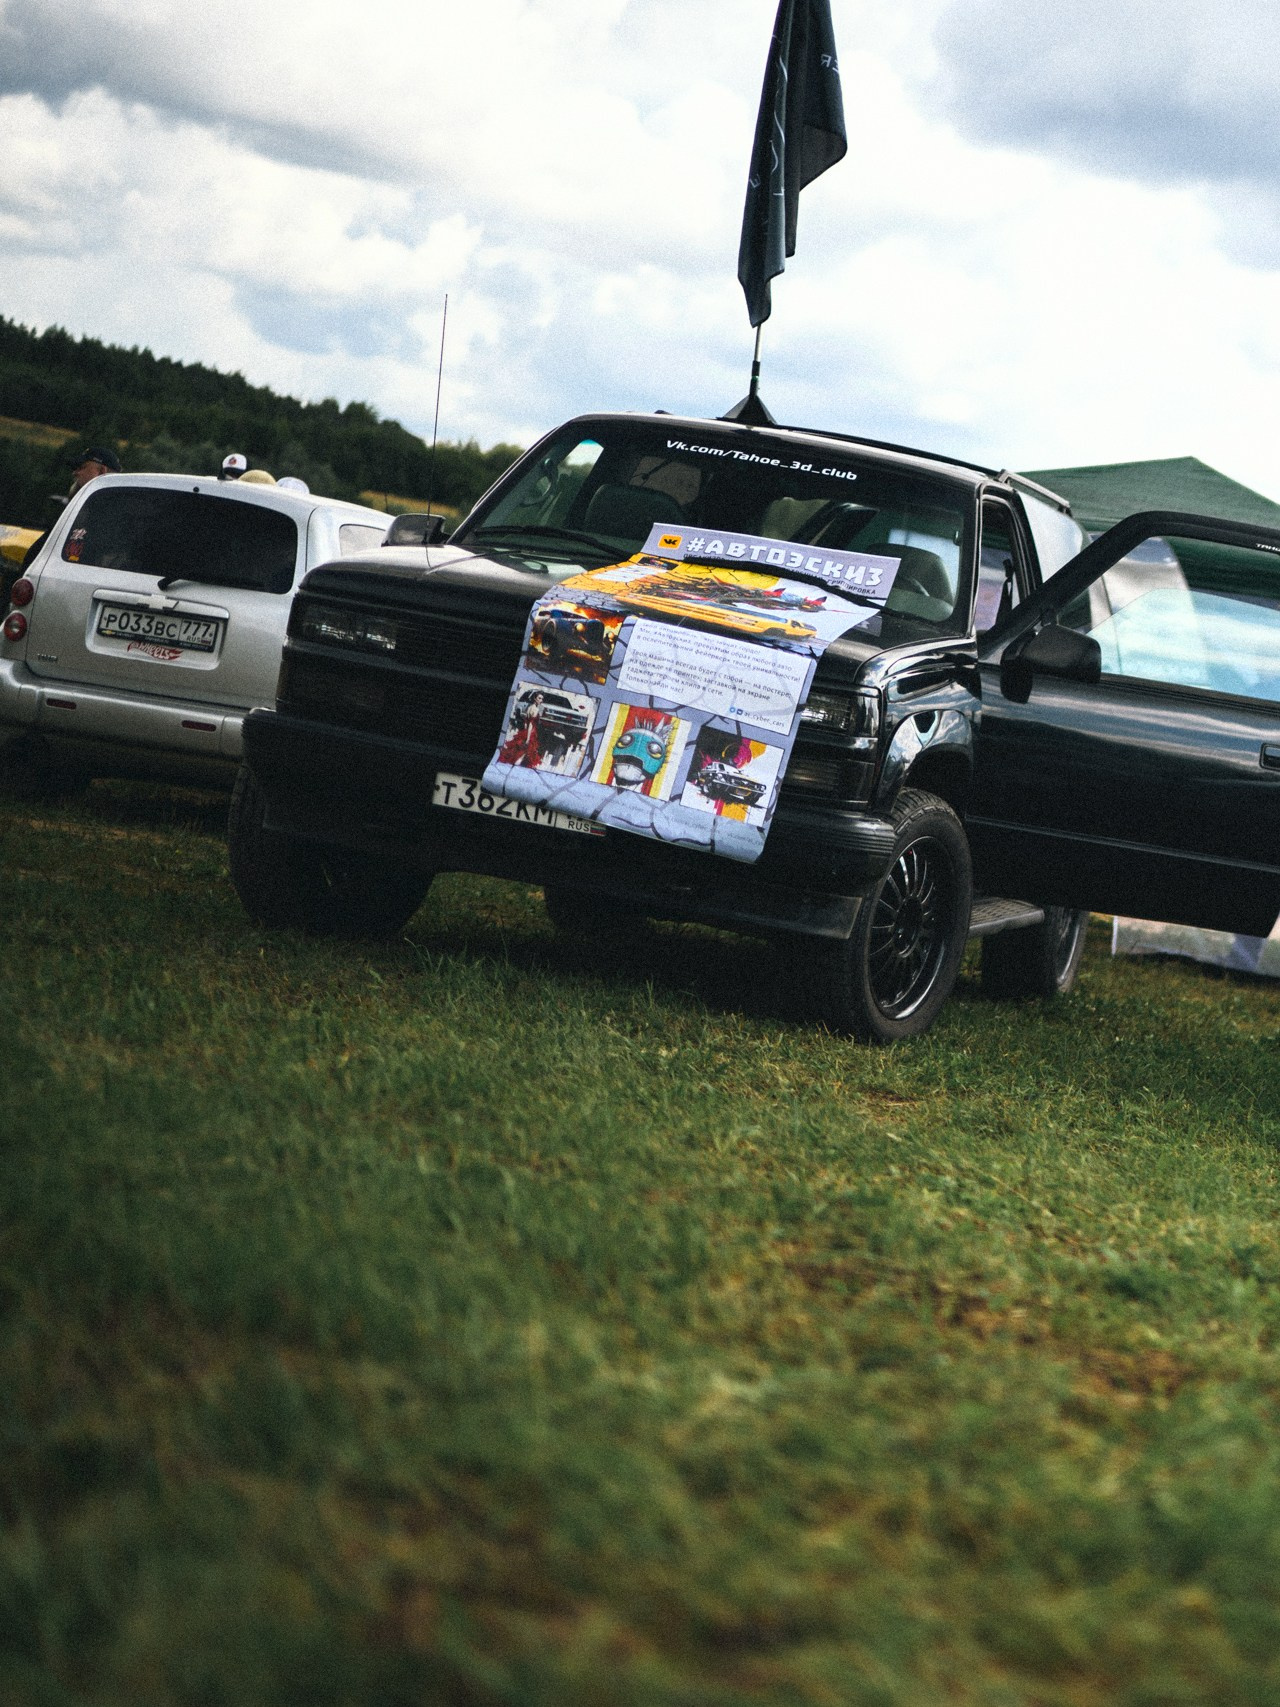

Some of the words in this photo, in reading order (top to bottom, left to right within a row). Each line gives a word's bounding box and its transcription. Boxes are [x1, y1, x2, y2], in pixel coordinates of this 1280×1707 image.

[666, 439, 858, 481] Vk.com/Tahoe_3d_club
[686, 536, 884, 587] #АВТОЭСКИЗ
[182, 619, 211, 638] 777
[186, 635, 201, 643] RUS
[568, 820, 590, 832] RUS
